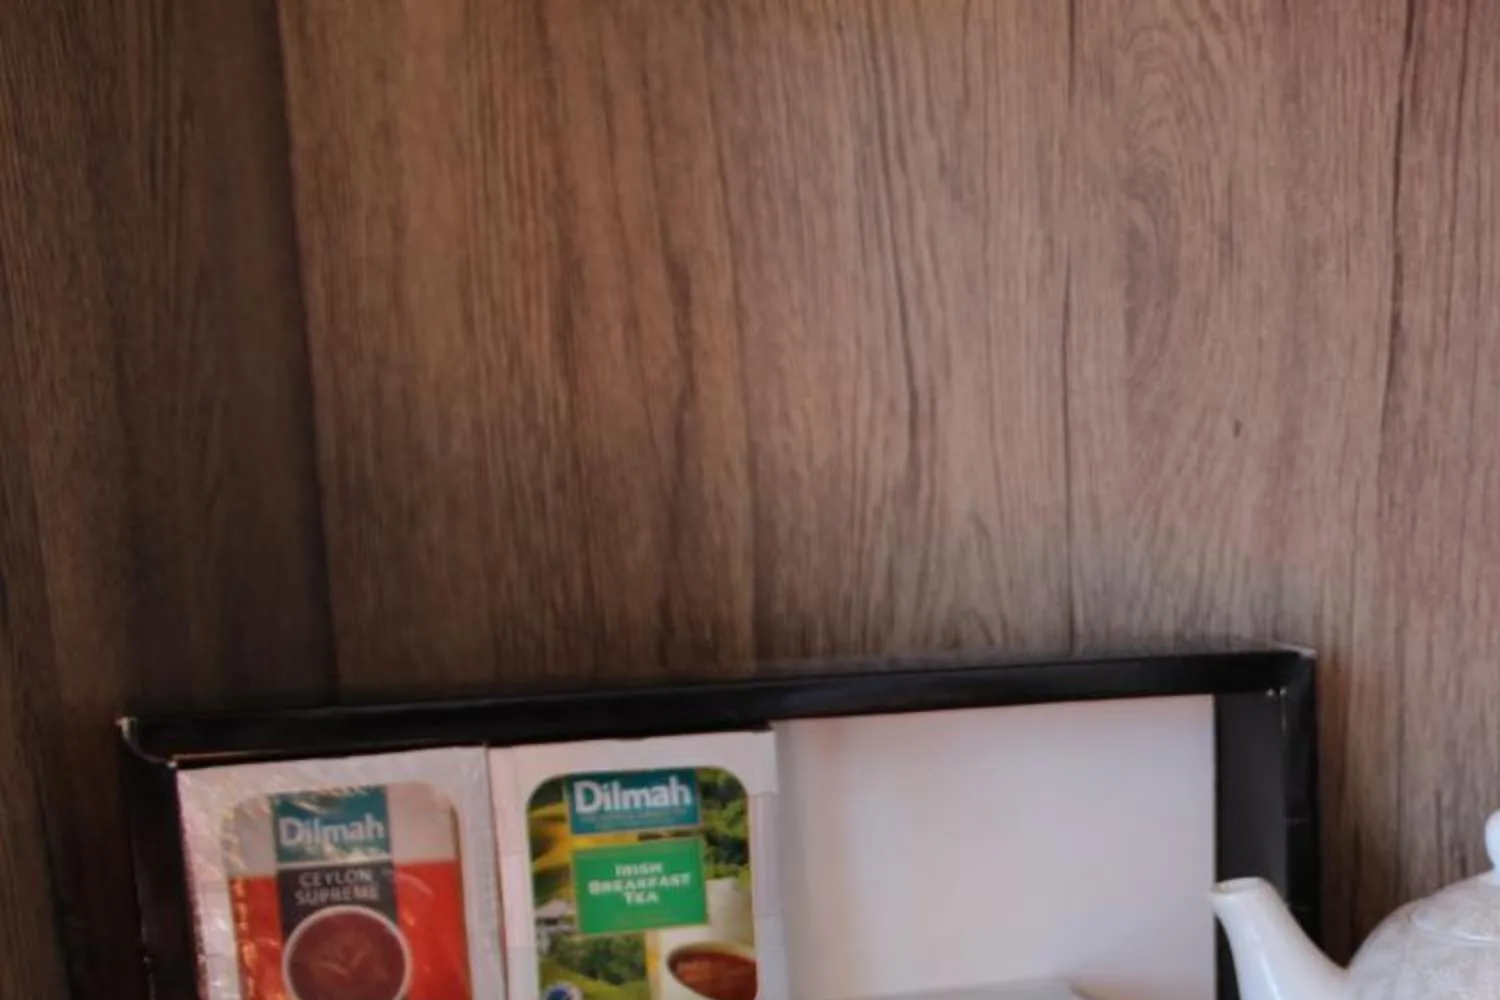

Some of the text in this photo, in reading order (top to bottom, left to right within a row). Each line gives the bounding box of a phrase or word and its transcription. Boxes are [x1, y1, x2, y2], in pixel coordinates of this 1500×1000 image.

[573, 776, 692, 814] Dilmah
[279, 812, 384, 846] Dilmah
[299, 868, 372, 887] CEYLON
[587, 872, 691, 895] BREAKFAST
[294, 885, 380, 905] SUPREME
[623, 891, 659, 906] TEA
